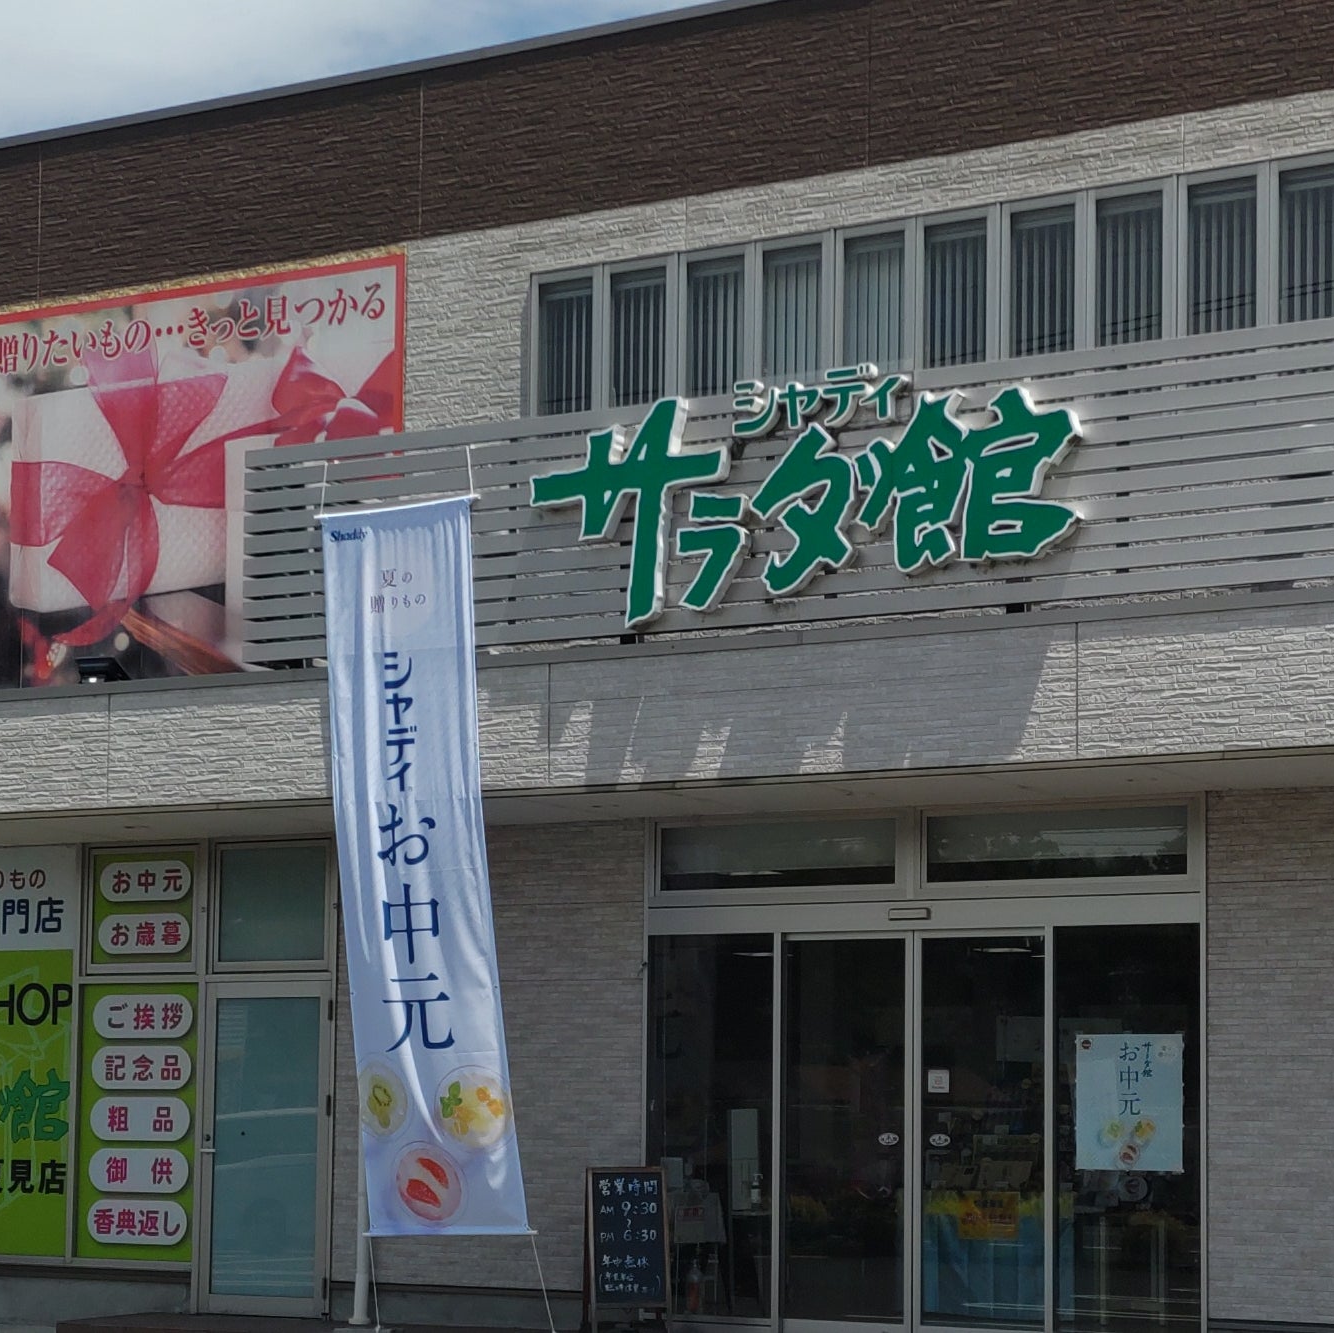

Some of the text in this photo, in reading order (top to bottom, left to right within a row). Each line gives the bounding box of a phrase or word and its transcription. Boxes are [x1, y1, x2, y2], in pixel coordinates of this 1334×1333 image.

[733, 362, 911, 436] シャディ
[530, 386, 1084, 628] サラダ館
[330, 526, 367, 543] Shaddy
[382, 569, 412, 588] 夏の
[370, 593, 426, 613] 贈りもの
[383, 652, 417, 792] シャディ
[112, 868, 183, 894] お中元
[111, 921, 182, 946] お歳暮
[377, 804, 455, 1053] お中元
[107, 1002, 183, 1031] ご挨拶
[104, 1054, 181, 1082] 記念品
[1119, 1042, 1141, 1116] お中元
[598, 1177, 658, 1196] 営業時間
[600, 1201, 657, 1216] AM 9:30
[93, 1210, 180, 1236] 香典返し
[600, 1229, 657, 1243] PM 6:30
